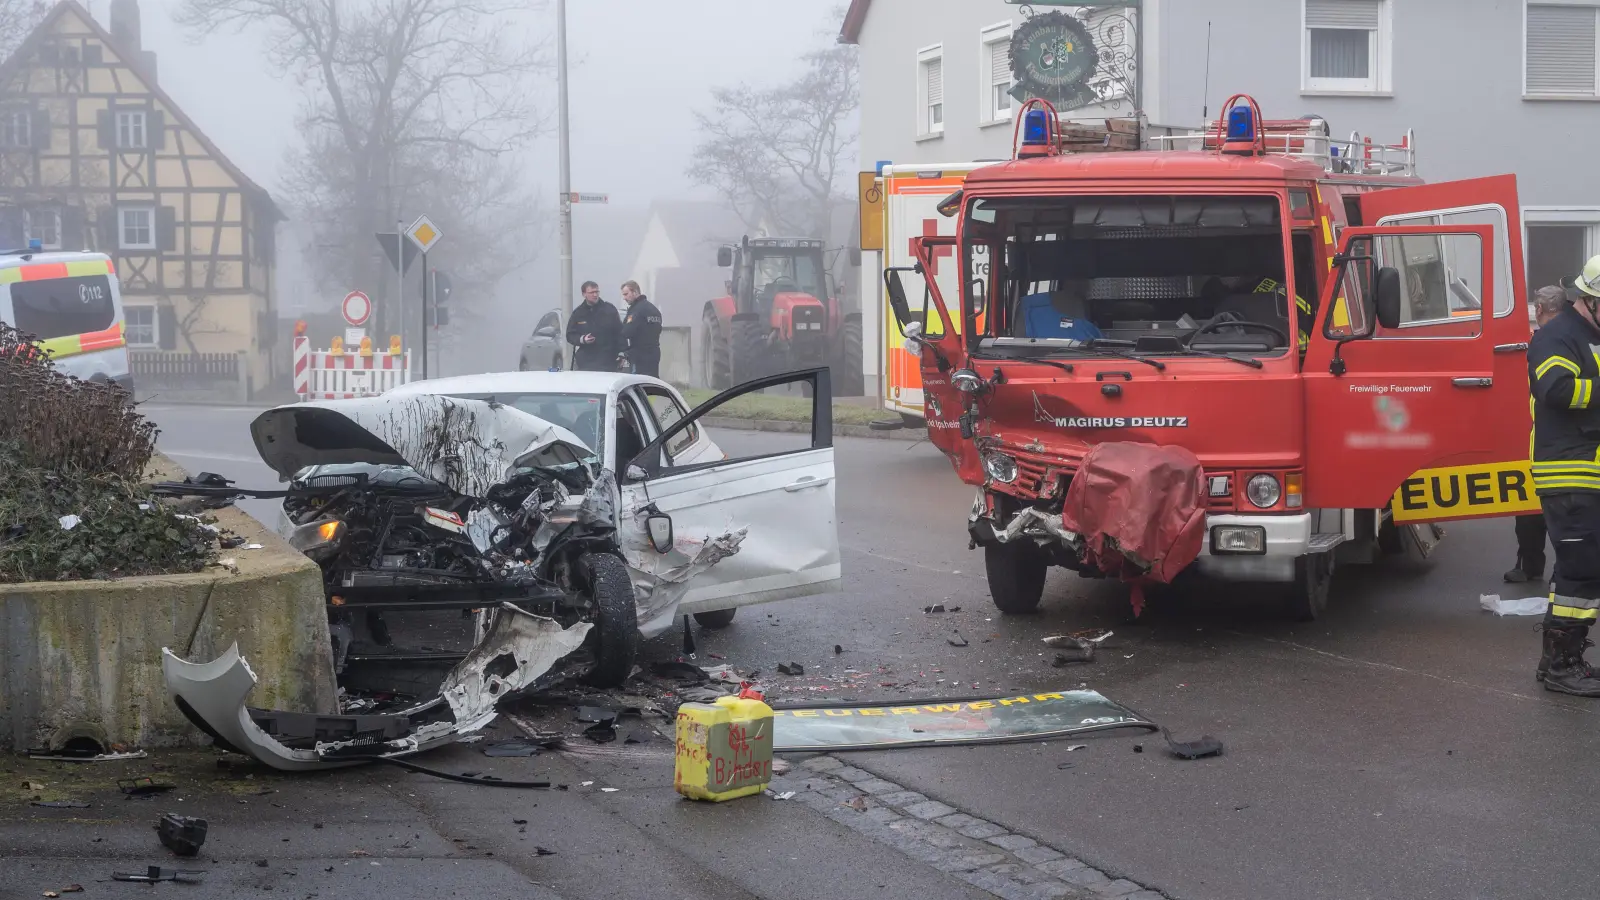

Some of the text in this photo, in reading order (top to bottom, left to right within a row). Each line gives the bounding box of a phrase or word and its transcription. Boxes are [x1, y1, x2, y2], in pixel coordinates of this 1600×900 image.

[89, 285, 103, 300] 112
[1349, 385, 1388, 394] Freiwillige
[1055, 416, 1187, 427] MAGIRUS DEUTZ
[1400, 469, 1535, 511] EUER
[715, 750, 770, 785] Binder
